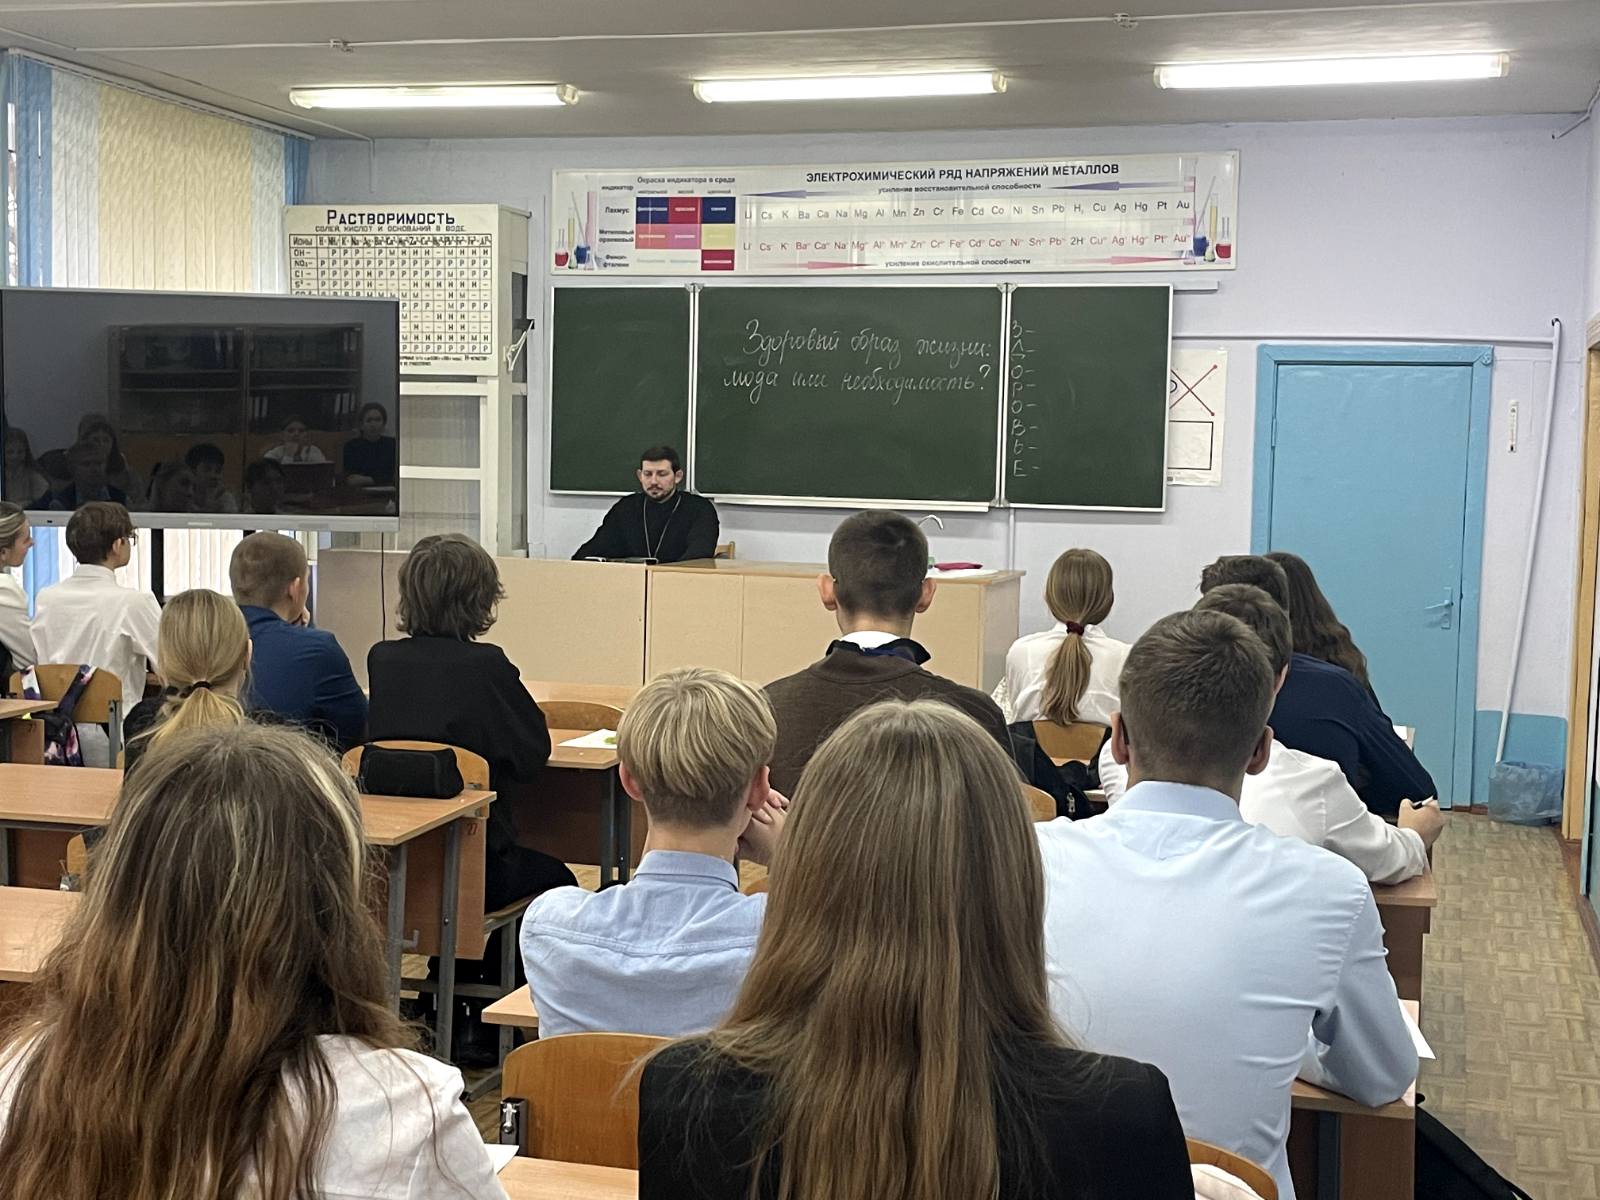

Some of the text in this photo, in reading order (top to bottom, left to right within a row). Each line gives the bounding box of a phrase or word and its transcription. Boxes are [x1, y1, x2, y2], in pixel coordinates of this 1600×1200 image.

[806, 164, 1119, 183] ЭЛЕКТРОХИМИЧЕСКИЙ РЯД НАПРЯЖЕНИЙ МЕТАЛЛОВ
[991, 182, 1042, 191] способности
[761, 212, 773, 220] Cs
[782, 210, 789, 218] K
[798, 211, 810, 220] Ba
[817, 210, 829, 218] Ca
[836, 210, 848, 218] Na
[854, 210, 868, 220] Mg
[876, 209, 885, 217] Al
[892, 209, 906, 218] Mn
[913, 208, 925, 216] Zn
[933, 207, 944, 216] Cr
[952, 207, 964, 215] Fe
[972, 207, 984, 216] Cd
[992, 206, 1004, 215] Co
[1013, 206, 1023, 214] Ni
[1032, 206, 1044, 214] Sn
[1052, 204, 1064, 213] Pb
[1093, 203, 1106, 212] Cu
[1114, 203, 1127, 213] Ag
[1134, 202, 1148, 212] Hg
[1157, 201, 1168, 210] Pt
[1176, 200, 1190, 209] Au
[743, 318, 840, 366] Здоровый
[851, 328, 902, 370] образ
[724, 368, 778, 404] мода
[792, 371, 828, 388] или
